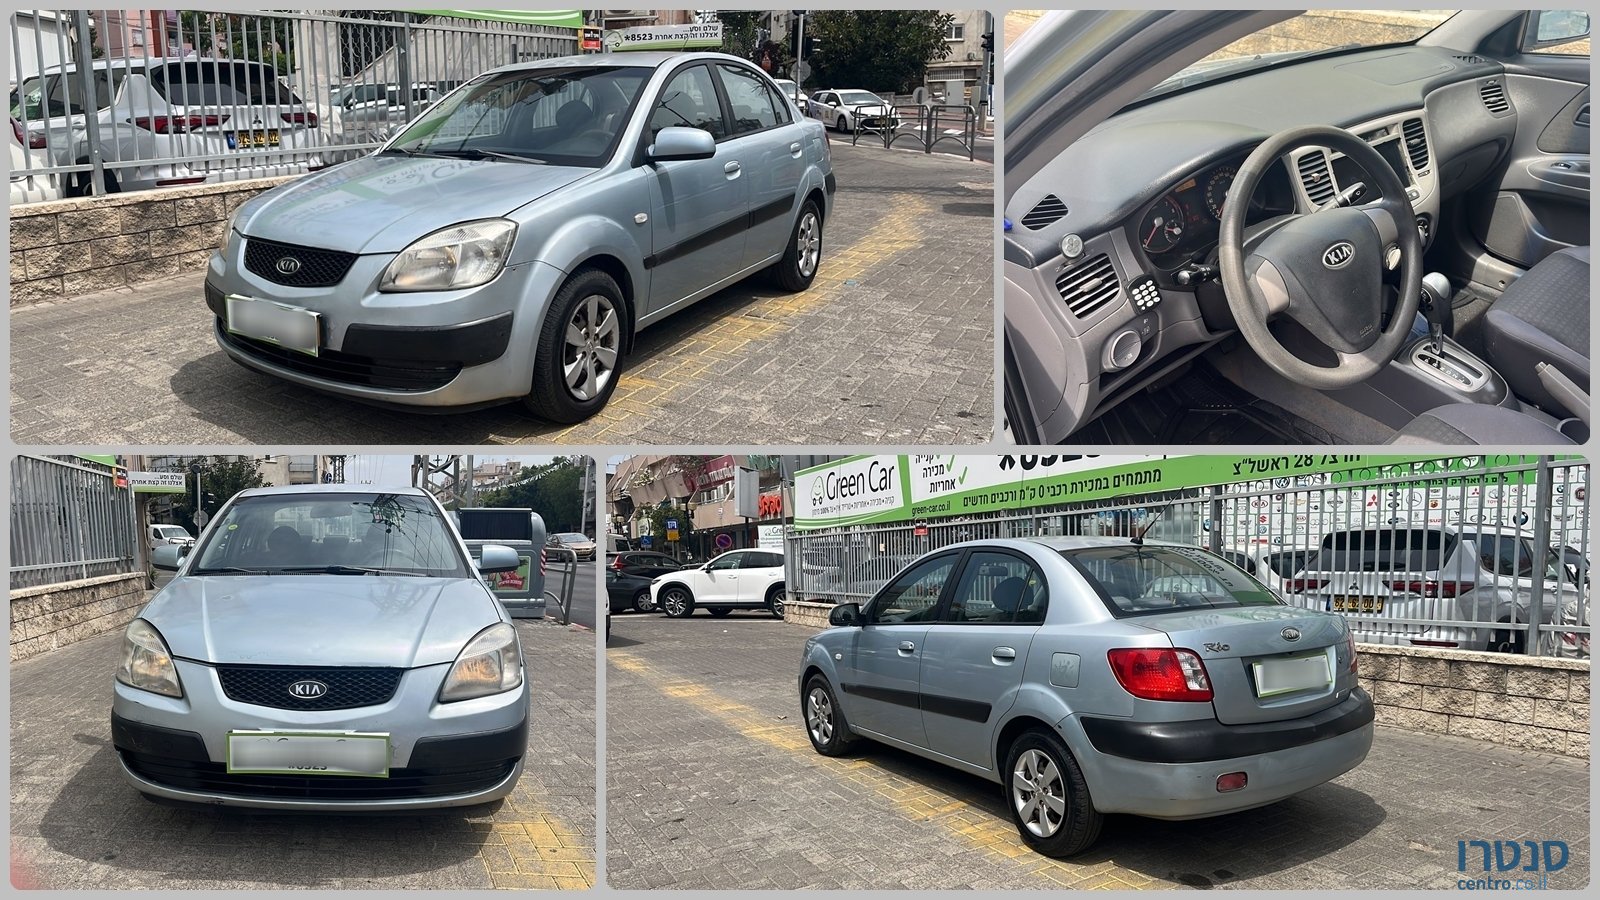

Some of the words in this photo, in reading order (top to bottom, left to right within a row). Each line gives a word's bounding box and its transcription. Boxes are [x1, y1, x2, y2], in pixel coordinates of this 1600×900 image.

[675, 33, 689, 41] קצת
[1327, 245, 1351, 265] KIA
[280, 260, 295, 271] KIA
[1294, 455, 1314, 468] 28
[922, 464, 945, 478] מכירה
[1113, 468, 1162, 487] מתמחים
[826, 471, 865, 500] Green
[868, 460, 895, 493] Car
[929, 478, 956, 493] אחריות
[1070, 477, 1110, 494] במכירת
[990, 490, 1017, 503] ורכבים
[1038, 484, 1045, 499] 0
[1046, 483, 1068, 498] רכבי
[963, 494, 989, 507] חדשים
[911, 500, 951, 517] green-car.co.il
[1203, 642, 1231, 652] Rio
[295, 684, 321, 695] KIA
